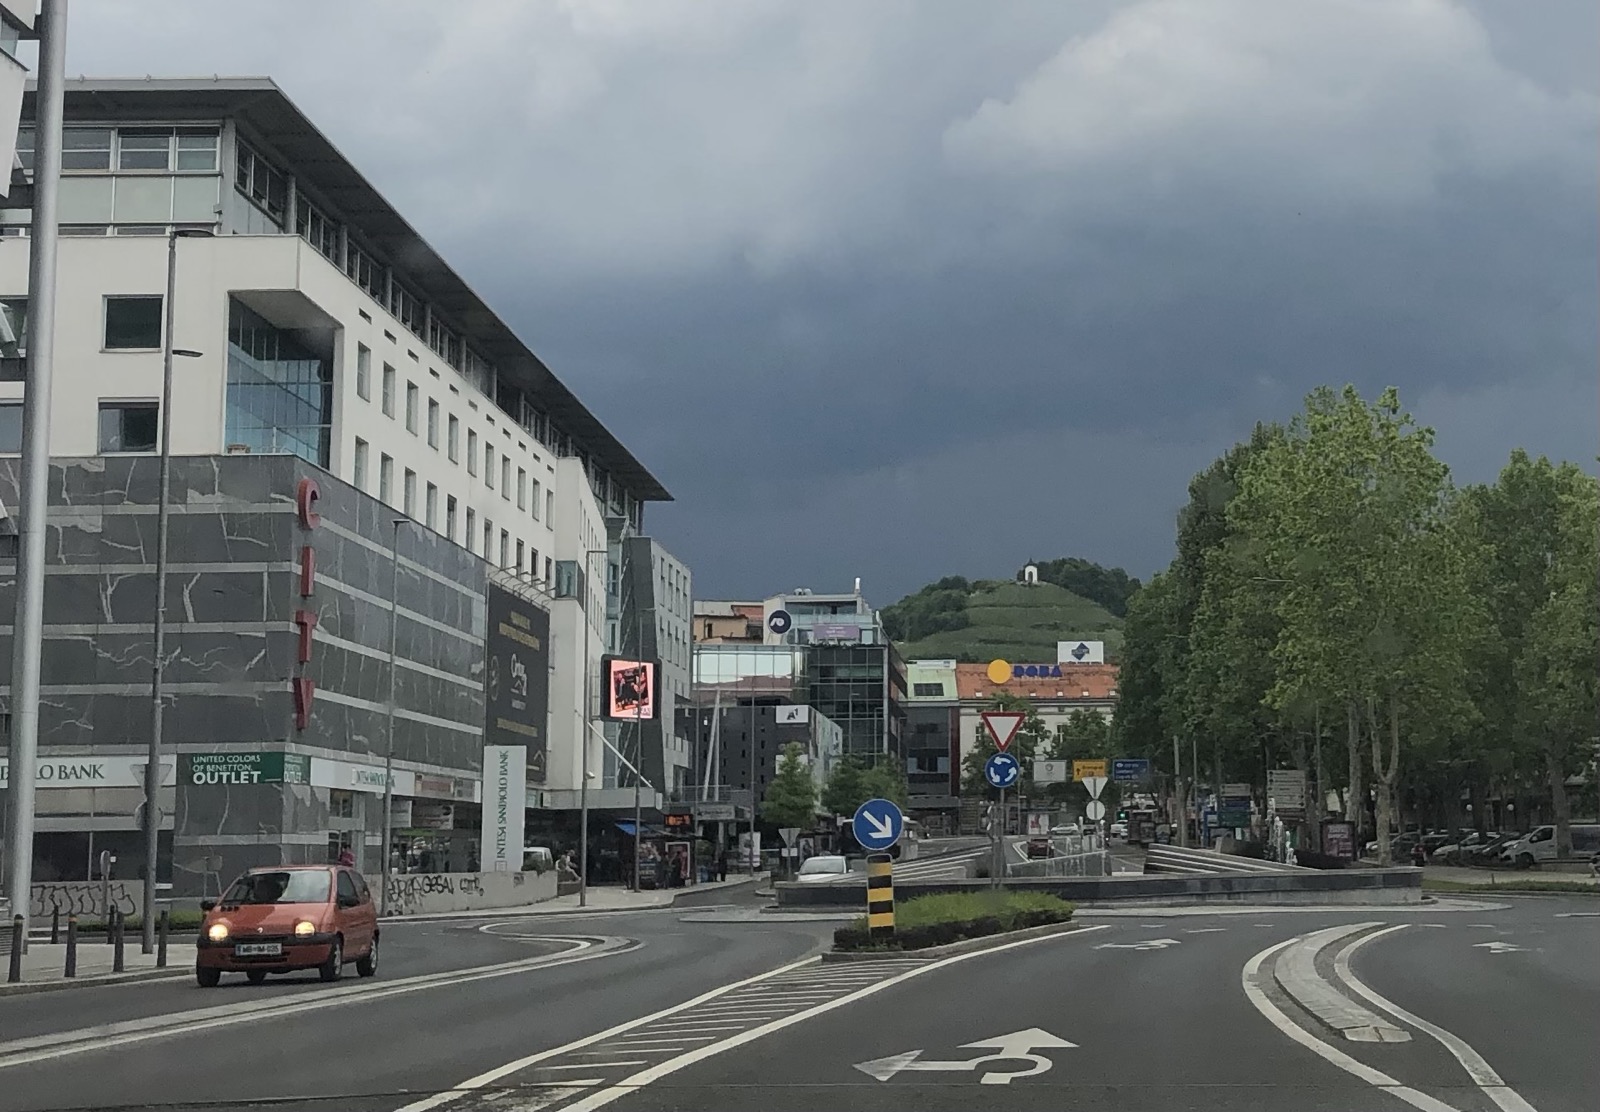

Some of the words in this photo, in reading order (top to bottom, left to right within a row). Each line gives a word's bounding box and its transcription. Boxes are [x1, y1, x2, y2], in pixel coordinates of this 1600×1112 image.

[294, 478, 321, 729] CITY
[193, 755, 225, 763] UNITED
[226, 754, 261, 763] COLORS
[499, 750, 509, 776] BANK
[58, 763, 105, 780] BANK
[192, 764, 205, 772] OF
[193, 771, 262, 785] OUTLET
[496, 826, 507, 859] INTESA
